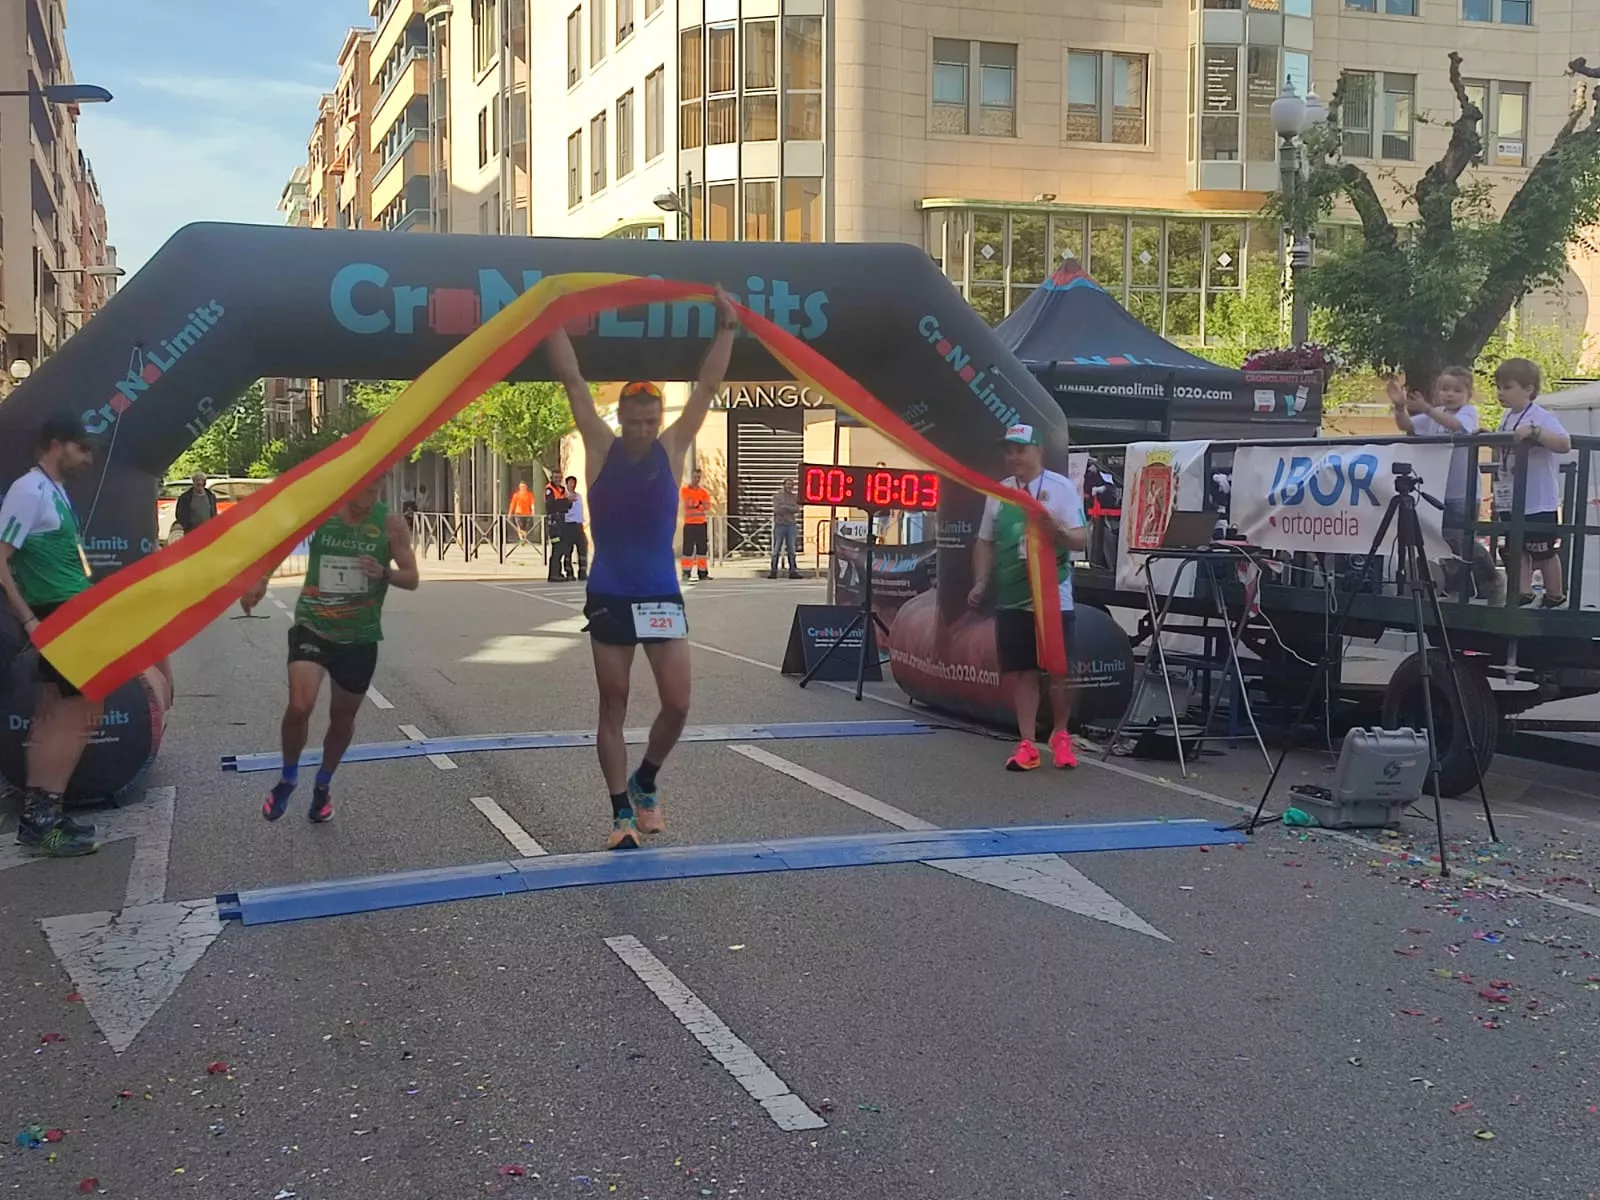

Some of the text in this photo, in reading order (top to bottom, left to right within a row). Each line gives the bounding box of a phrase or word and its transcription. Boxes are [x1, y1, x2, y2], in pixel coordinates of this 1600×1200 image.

[710, 385, 824, 409] MANGO
[1268, 454, 1381, 507] IBOR
[1282, 511, 1359, 541] ortopedia
[321, 535, 377, 552] Huesca
[338, 571, 344, 582] 1
[649, 617, 673, 629] 221
